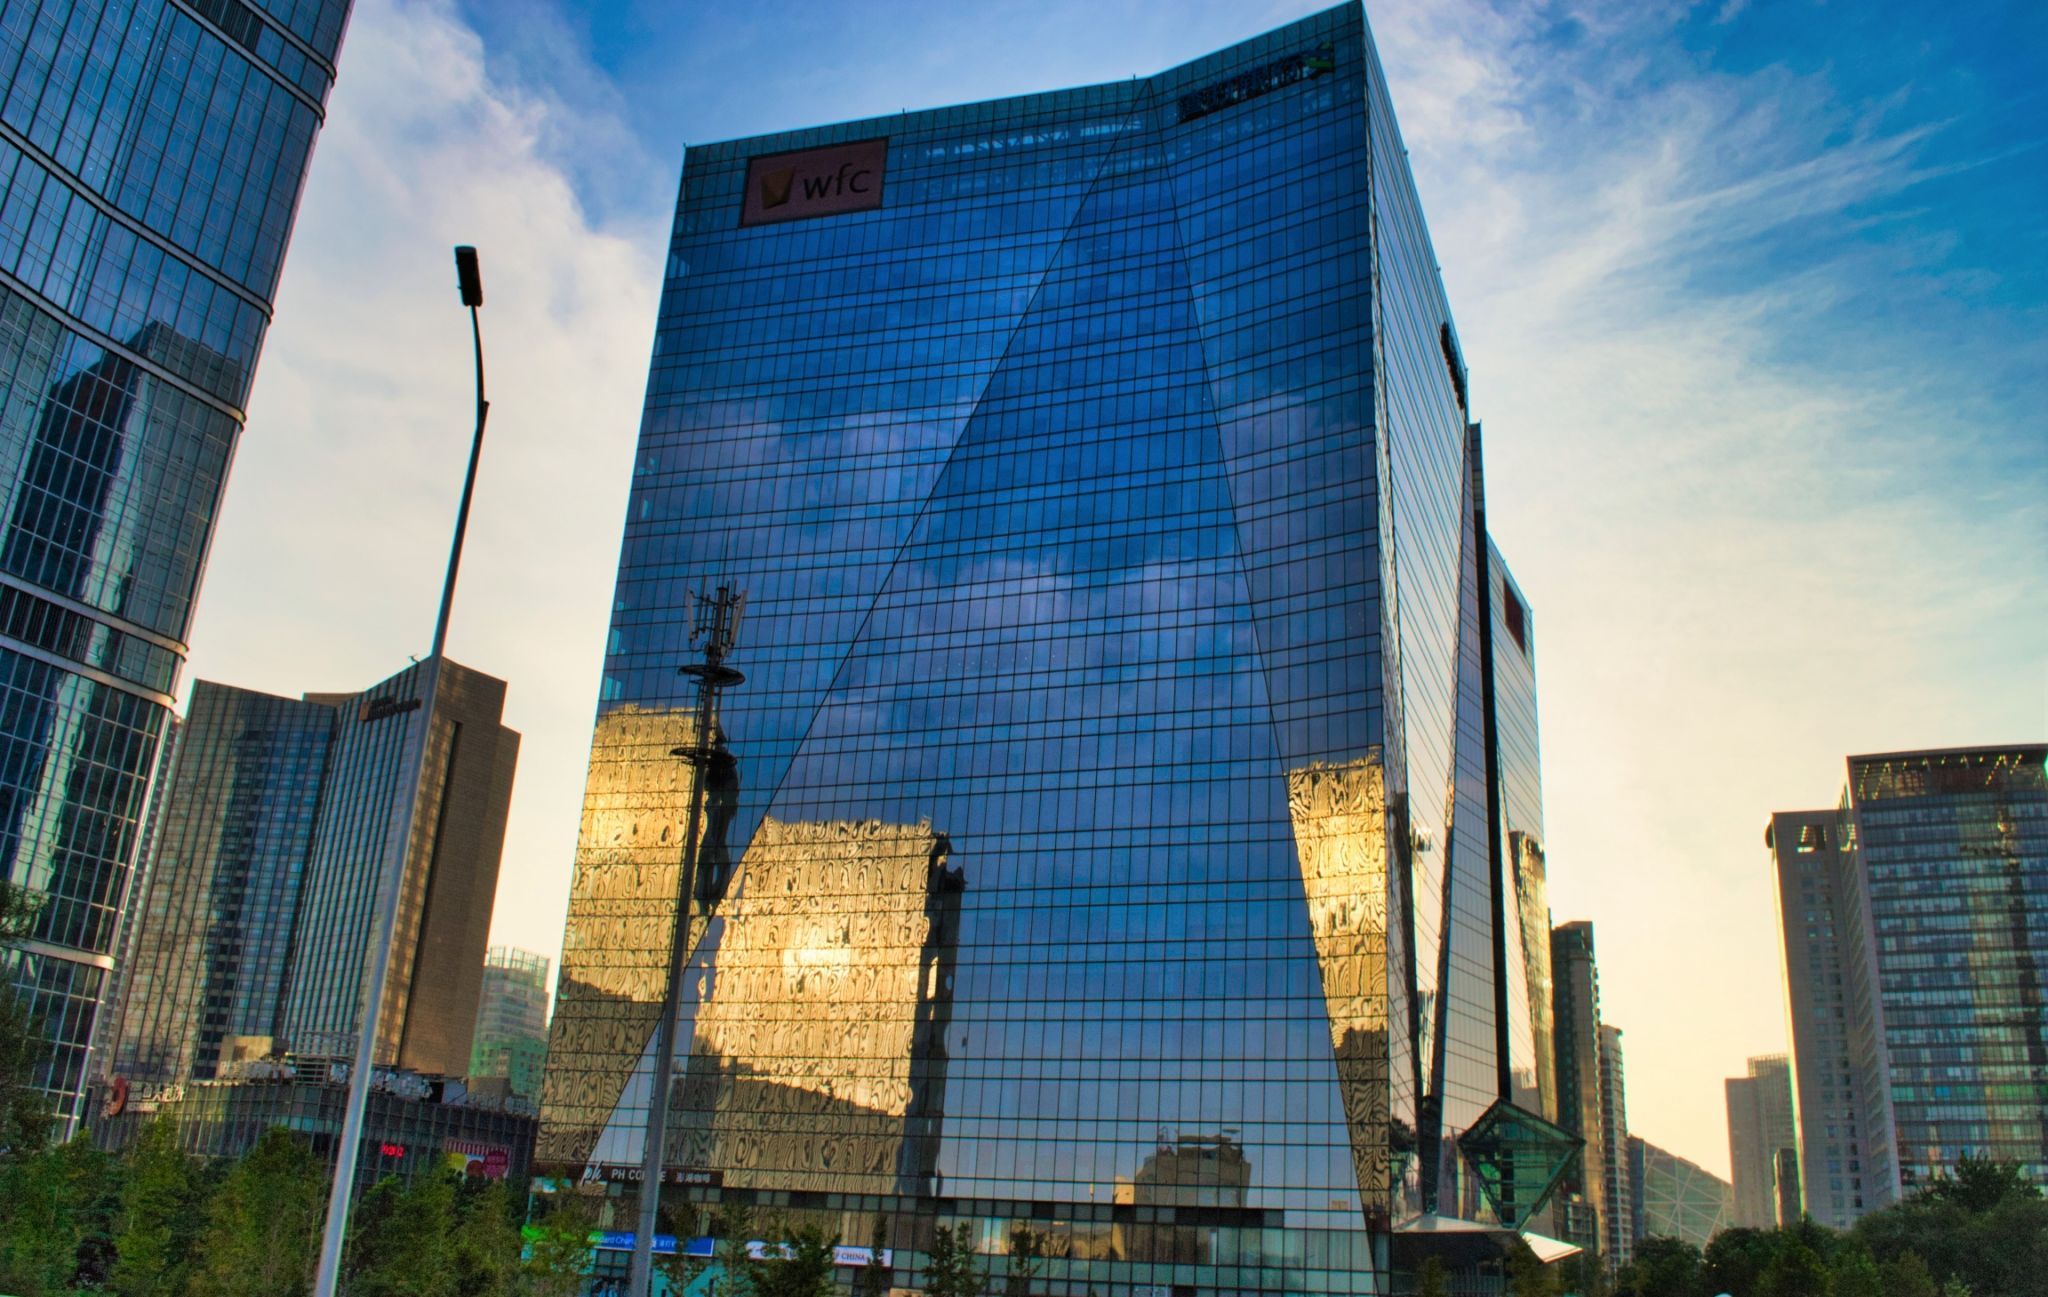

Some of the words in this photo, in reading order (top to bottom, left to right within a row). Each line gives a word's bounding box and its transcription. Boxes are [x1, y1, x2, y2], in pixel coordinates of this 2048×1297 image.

[803, 163, 871, 200] wfc
[611, 1168, 626, 1180] PH
[628, 1169, 667, 1182] COE
[841, 1252, 865, 1262] CHINA
